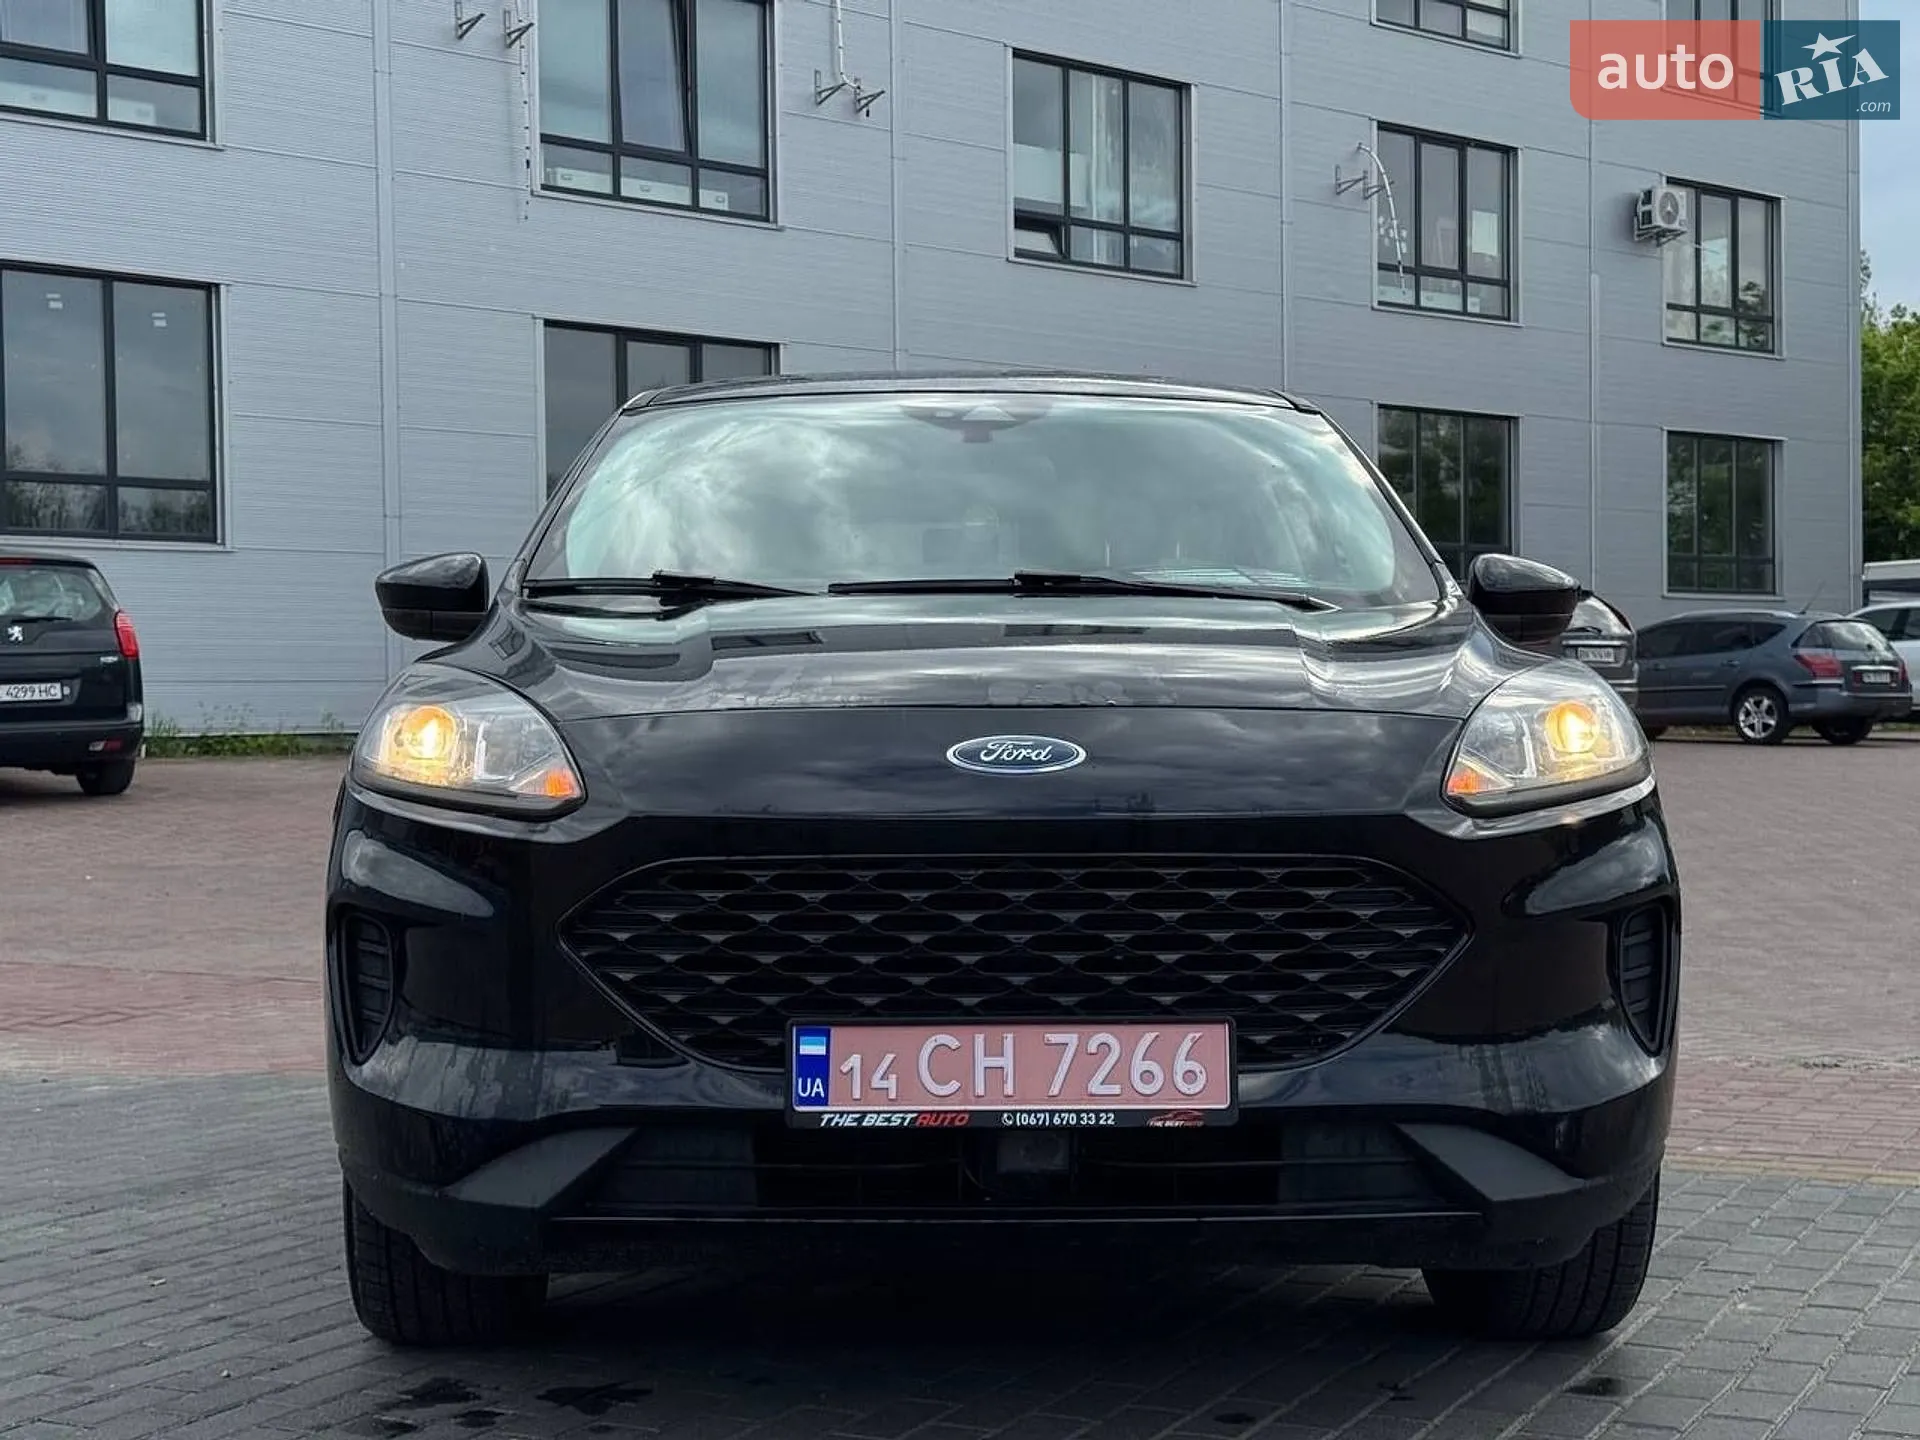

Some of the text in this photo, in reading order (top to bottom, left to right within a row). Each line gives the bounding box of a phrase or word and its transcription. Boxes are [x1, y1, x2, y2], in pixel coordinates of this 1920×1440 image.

[6, 685, 57, 699] 4299 HC
[980, 741, 1052, 761] Ford
[840, 1031, 1208, 1100] 14 CH 7266
[798, 1078, 825, 1098] UA
[820, 1113, 862, 1127] THE
[1016, 1112, 1115, 1126] (067) 670 33 22
